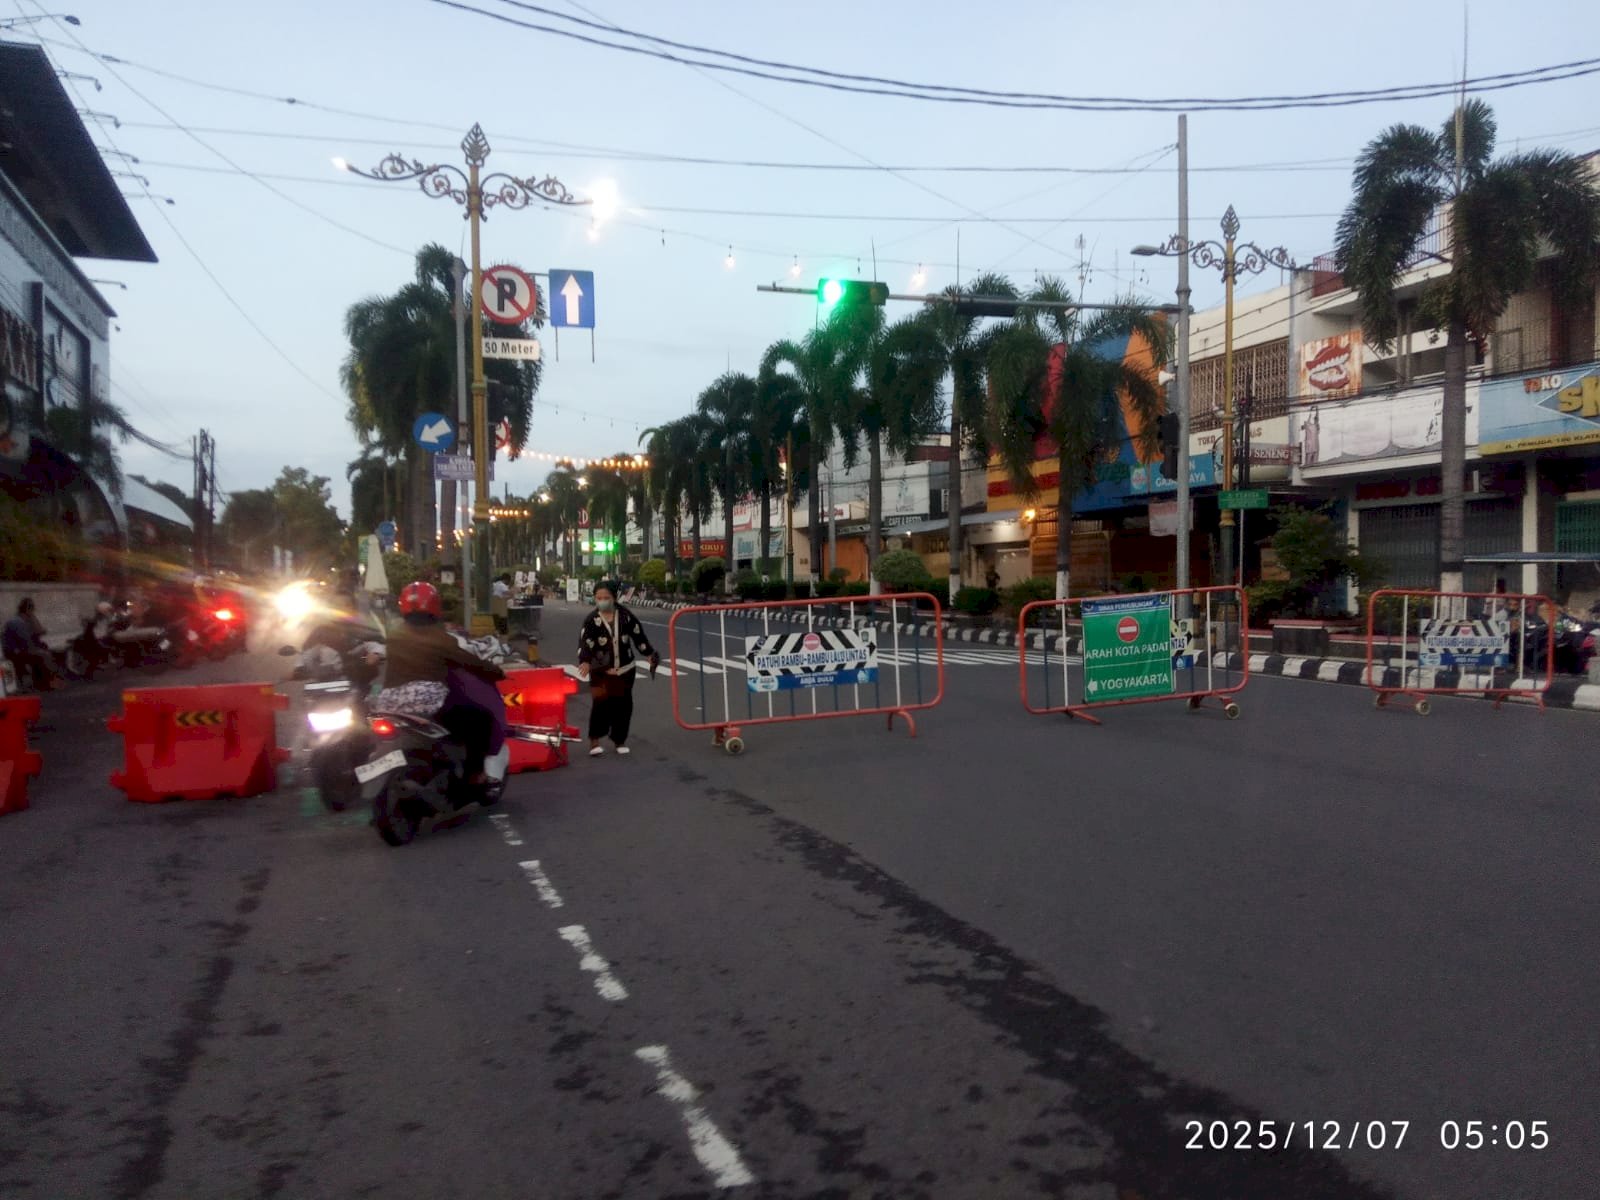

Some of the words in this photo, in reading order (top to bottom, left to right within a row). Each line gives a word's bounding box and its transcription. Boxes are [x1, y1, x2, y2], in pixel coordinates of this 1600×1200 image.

[497, 278, 516, 312] P
[484, 342, 498, 354] 50
[501, 342, 535, 354] Meter
[1524, 375, 1561, 392] TOKO
[1254, 448, 1290, 460] SENENG
[757, 655, 781, 668] PATUHI
[781, 651, 830, 667] RAMBU-RAMBU
[830, 650, 847, 664] LALU
[846, 649, 867, 662] LINTAS
[1086, 648, 1113, 659] ARAH
[1115, 646, 1140, 656] KOTA
[1141, 642, 1169, 653] PADAT
[1100, 673, 1169, 690] YOGYAKARTA
